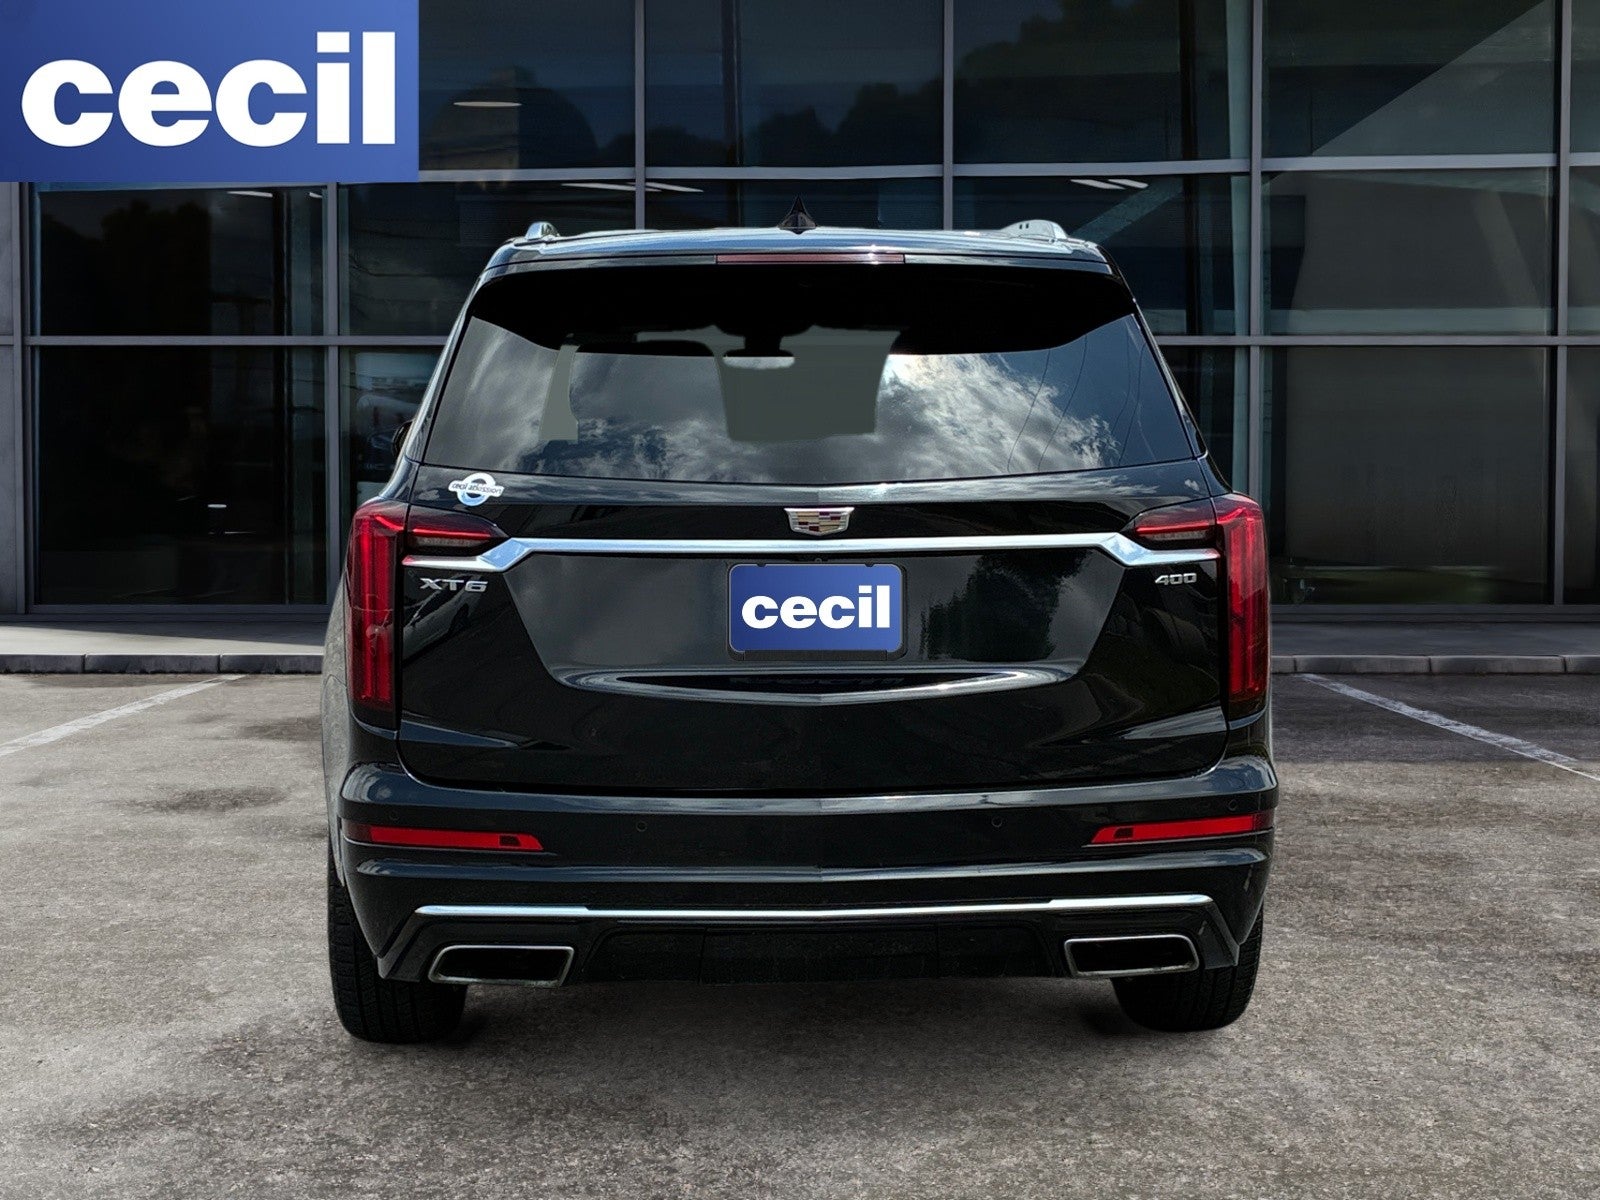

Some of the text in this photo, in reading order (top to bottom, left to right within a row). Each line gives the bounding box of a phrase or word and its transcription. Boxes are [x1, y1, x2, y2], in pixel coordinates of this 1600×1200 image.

[420, 578, 488, 592] XT6
[1154, 572, 1198, 585] 400
[741, 585, 891, 629] cecil
